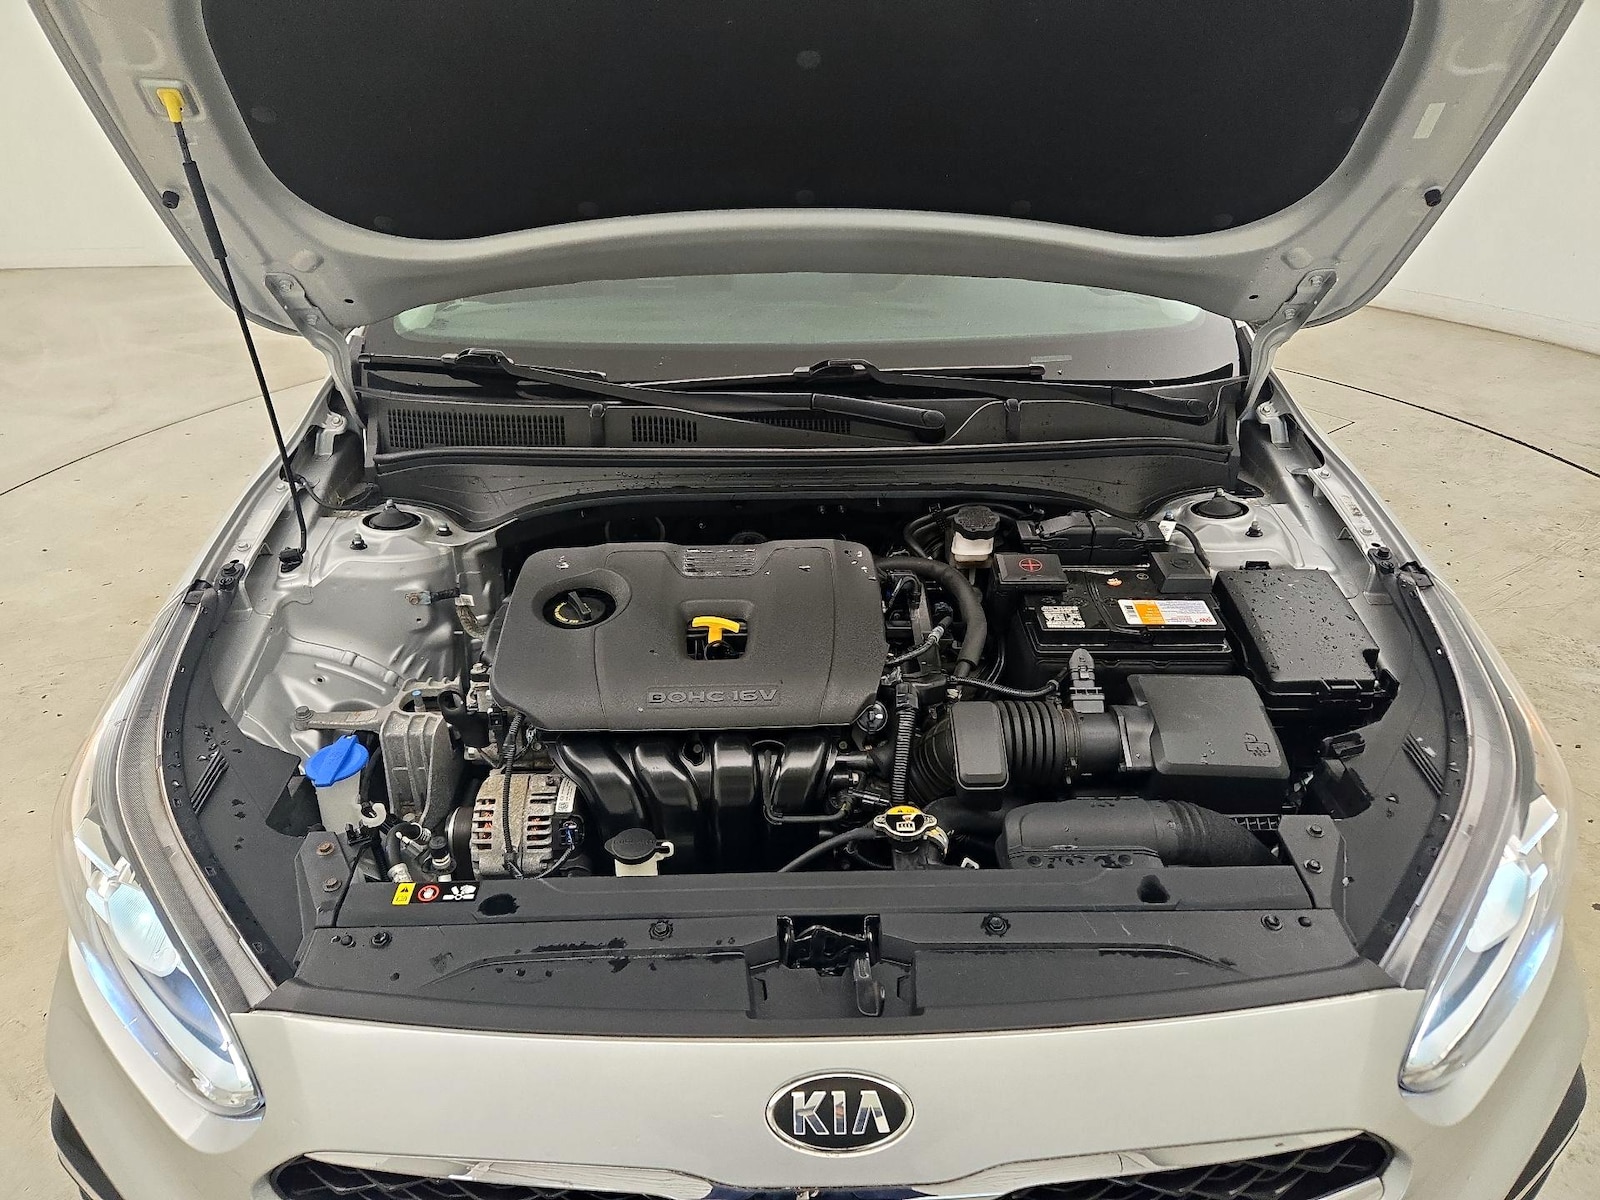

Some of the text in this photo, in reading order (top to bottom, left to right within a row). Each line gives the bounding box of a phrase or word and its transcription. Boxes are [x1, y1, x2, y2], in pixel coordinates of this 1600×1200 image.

[648, 689, 778, 703] DOHC 16V
[791, 1090, 891, 1135] KIA
